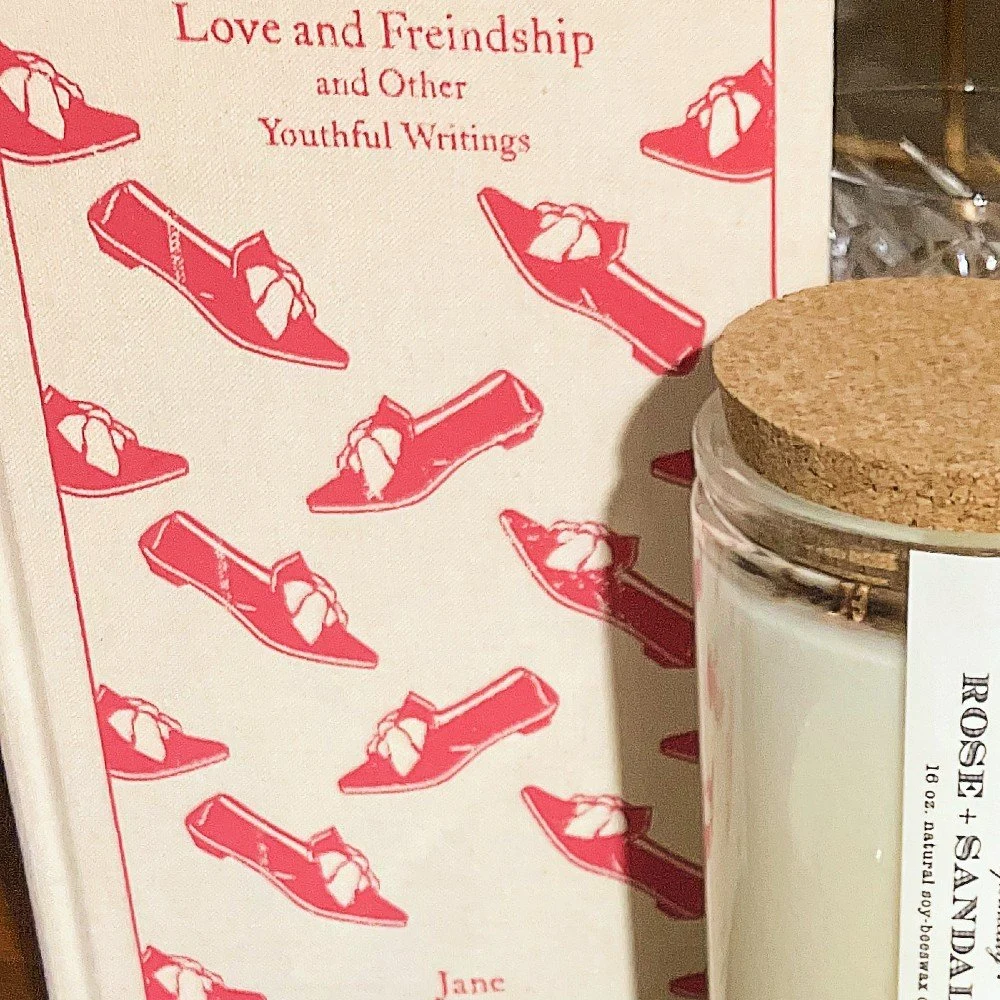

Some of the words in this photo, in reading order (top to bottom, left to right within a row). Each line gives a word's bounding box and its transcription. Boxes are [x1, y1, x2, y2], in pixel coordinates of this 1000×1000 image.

[174, 2, 282, 46] Love
[294, 10, 365, 49] and
[380, 11, 595, 68] Freindship
[316, 68, 368, 97] and
[379, 69, 467, 100] Other
[258, 117, 393, 151] Youthful
[400, 122, 531, 162] Writings
[958, 673, 990, 798] ROSE
[925, 764, 940, 784] 16
[922, 821, 936, 884] natural
[917, 890, 933, 991] soy-beeswax
